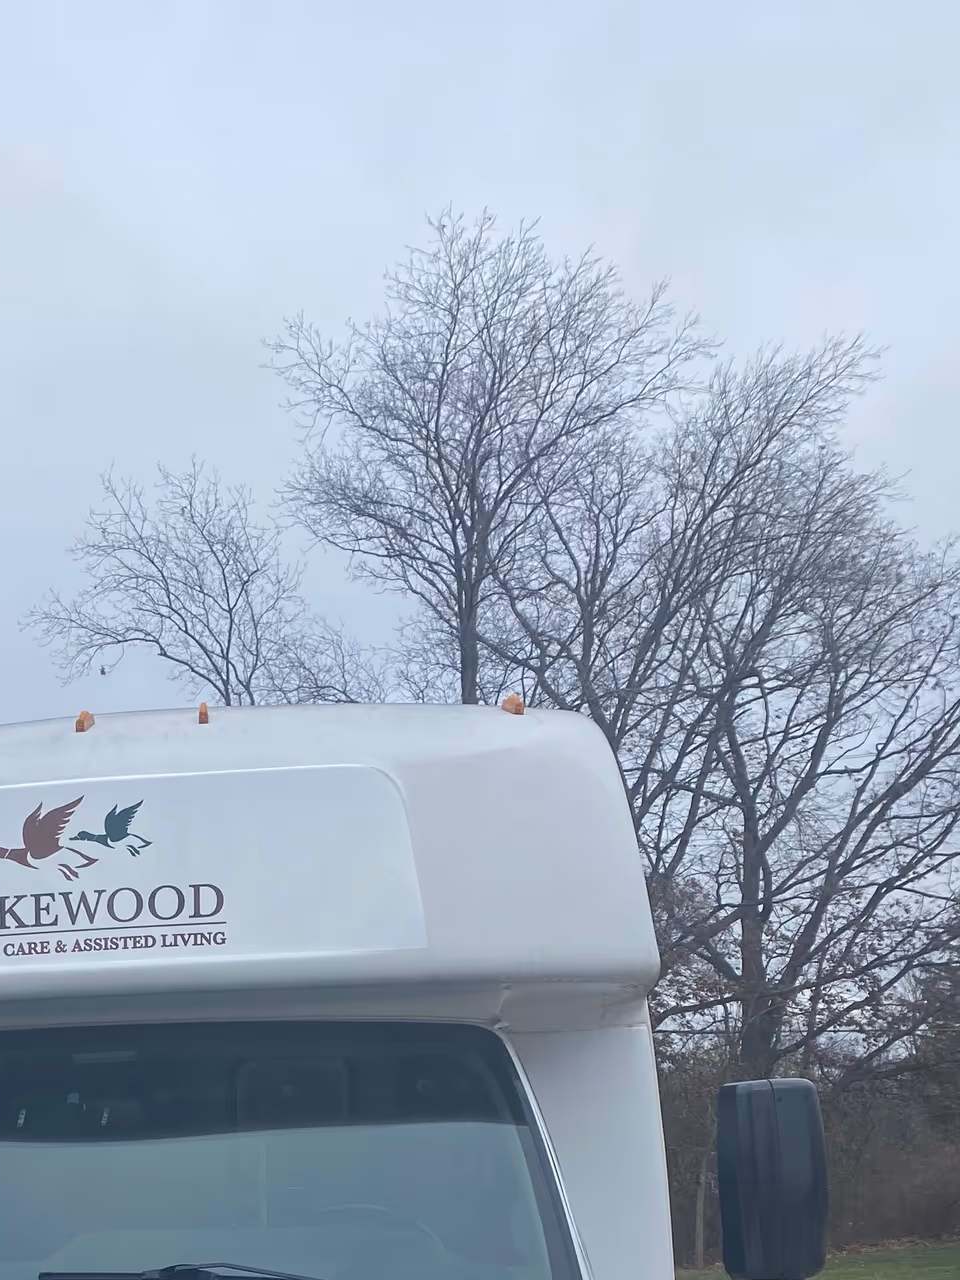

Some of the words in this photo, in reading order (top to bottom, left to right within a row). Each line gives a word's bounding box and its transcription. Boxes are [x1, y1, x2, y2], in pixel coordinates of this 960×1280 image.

[3, 941, 51, 957] CARE
[54, 940, 67, 953] &
[71, 934, 157, 952] ASSISTED
[160, 931, 227, 947] LIVING
